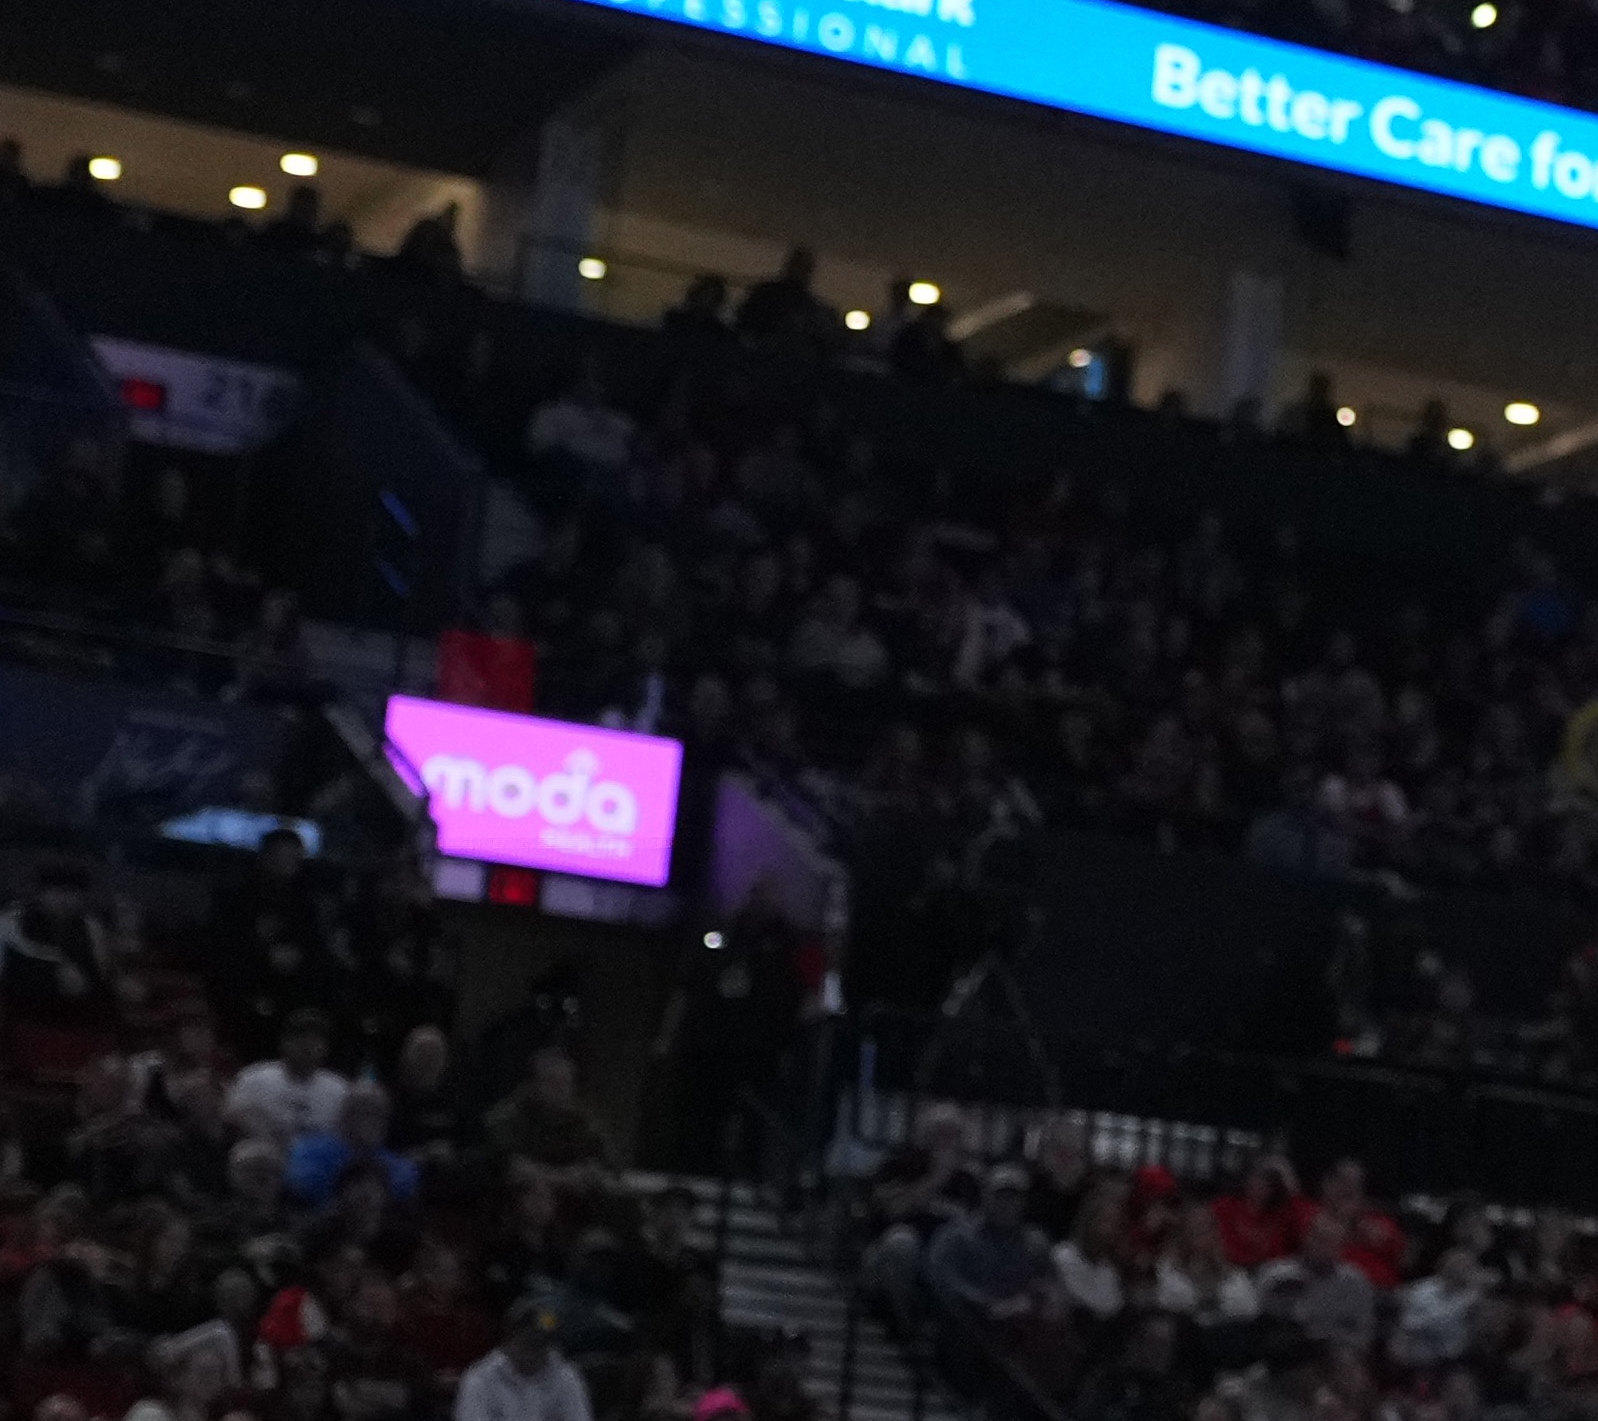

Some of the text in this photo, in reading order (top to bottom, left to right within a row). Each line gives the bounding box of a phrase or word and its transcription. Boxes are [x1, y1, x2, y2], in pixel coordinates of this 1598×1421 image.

[1153, 45, 1359, 140] Better
[1371, 97, 1519, 180] Care
[420, 746, 638, 837] moda
